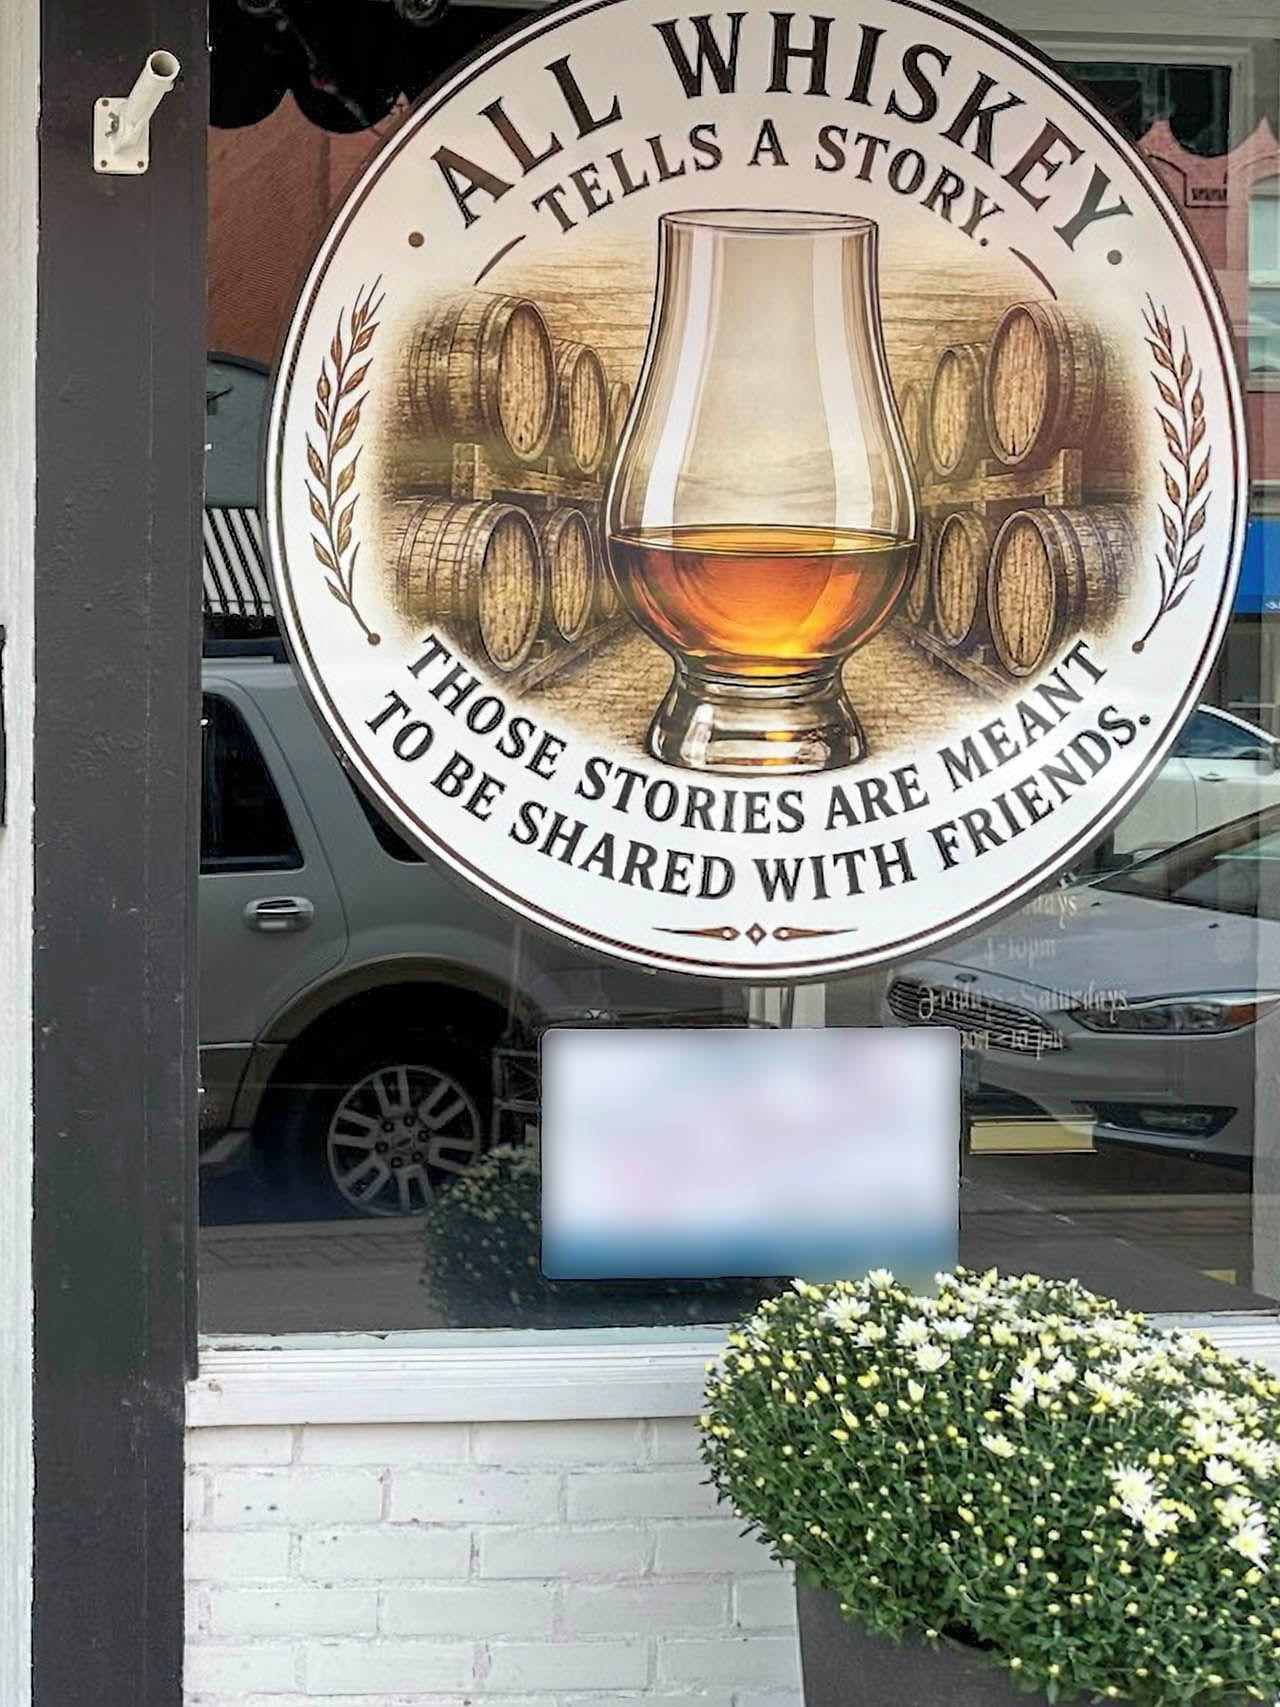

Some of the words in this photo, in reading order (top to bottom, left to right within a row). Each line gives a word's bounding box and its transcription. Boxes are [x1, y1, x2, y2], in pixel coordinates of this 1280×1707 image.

[430, 54, 623, 229] ALL
[652, 11, 1133, 252] WHISKEY
[531, 123, 722, 235] TELLS
[747, 118, 789, 167] A
[815, 124, 1005, 248] STORY.
[364, 690, 435, 762] TO
[430, 750, 507, 822] BE
[508, 799, 736, 900] SHARED
[752, 836, 918, 902] WITH
[927, 704, 1151, 871] FRIENDS.
[406, 633, 568, 780] THOSE
[575, 755, 805, 834] STORIES
[824, 761, 930, 831] ARE
[936, 639, 1108, 792] MEANT
